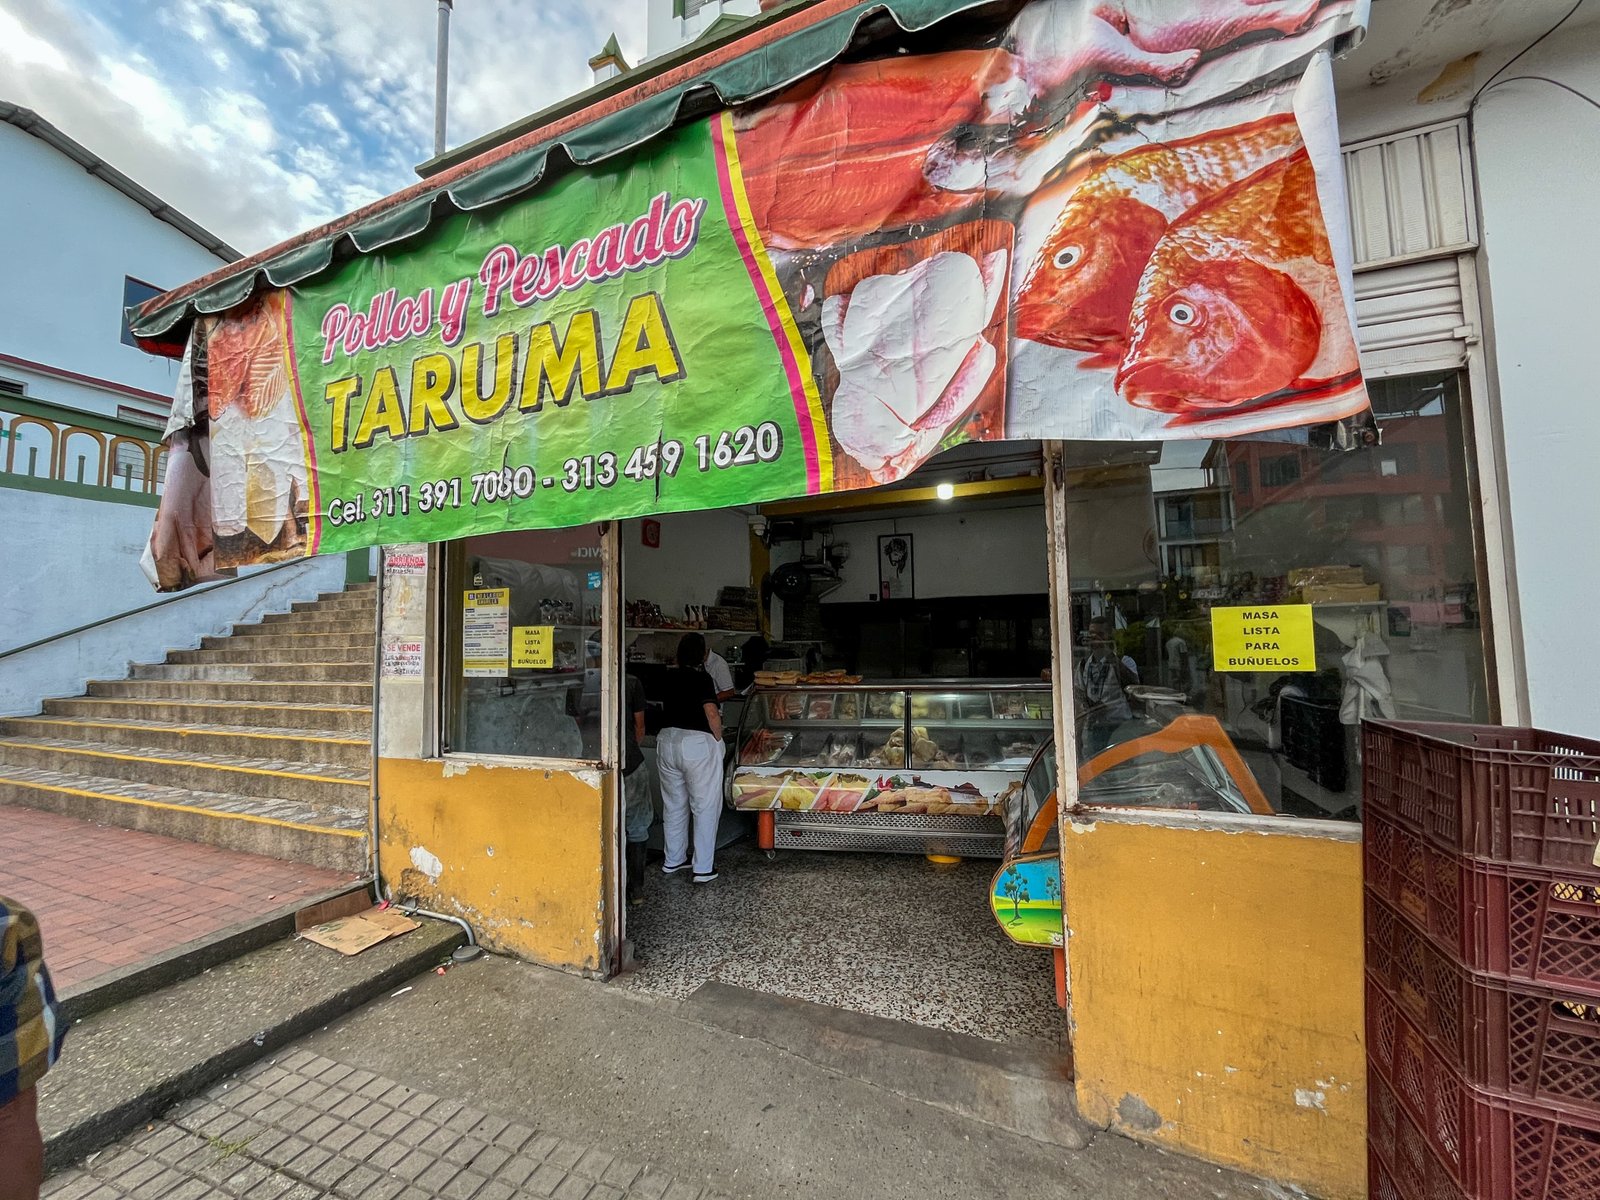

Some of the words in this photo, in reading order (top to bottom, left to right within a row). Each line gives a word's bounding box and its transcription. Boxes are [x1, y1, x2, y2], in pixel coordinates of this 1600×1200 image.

[321, 288, 434, 365] Pollos
[439, 278, 473, 348] y
[479, 192, 706, 317] Pescado
[324, 291, 686, 453] TARUMA
[327, 497, 366, 526] Cel.
[370, 484, 411, 518] 311
[418, 477, 462, 510] 391
[561, 451, 618, 493] 313
[624, 438, 685, 481] 459
[693, 420, 784, 472] 1620
[1242, 611, 1278, 619] MASA
[1243, 627, 1280, 635] LISTA
[387, 643, 396, 652] SE
[398, 643, 421, 652] VENDE
[1245, 642, 1280, 650] PARA
[1228, 656, 1299, 666] BUÑUELOS
